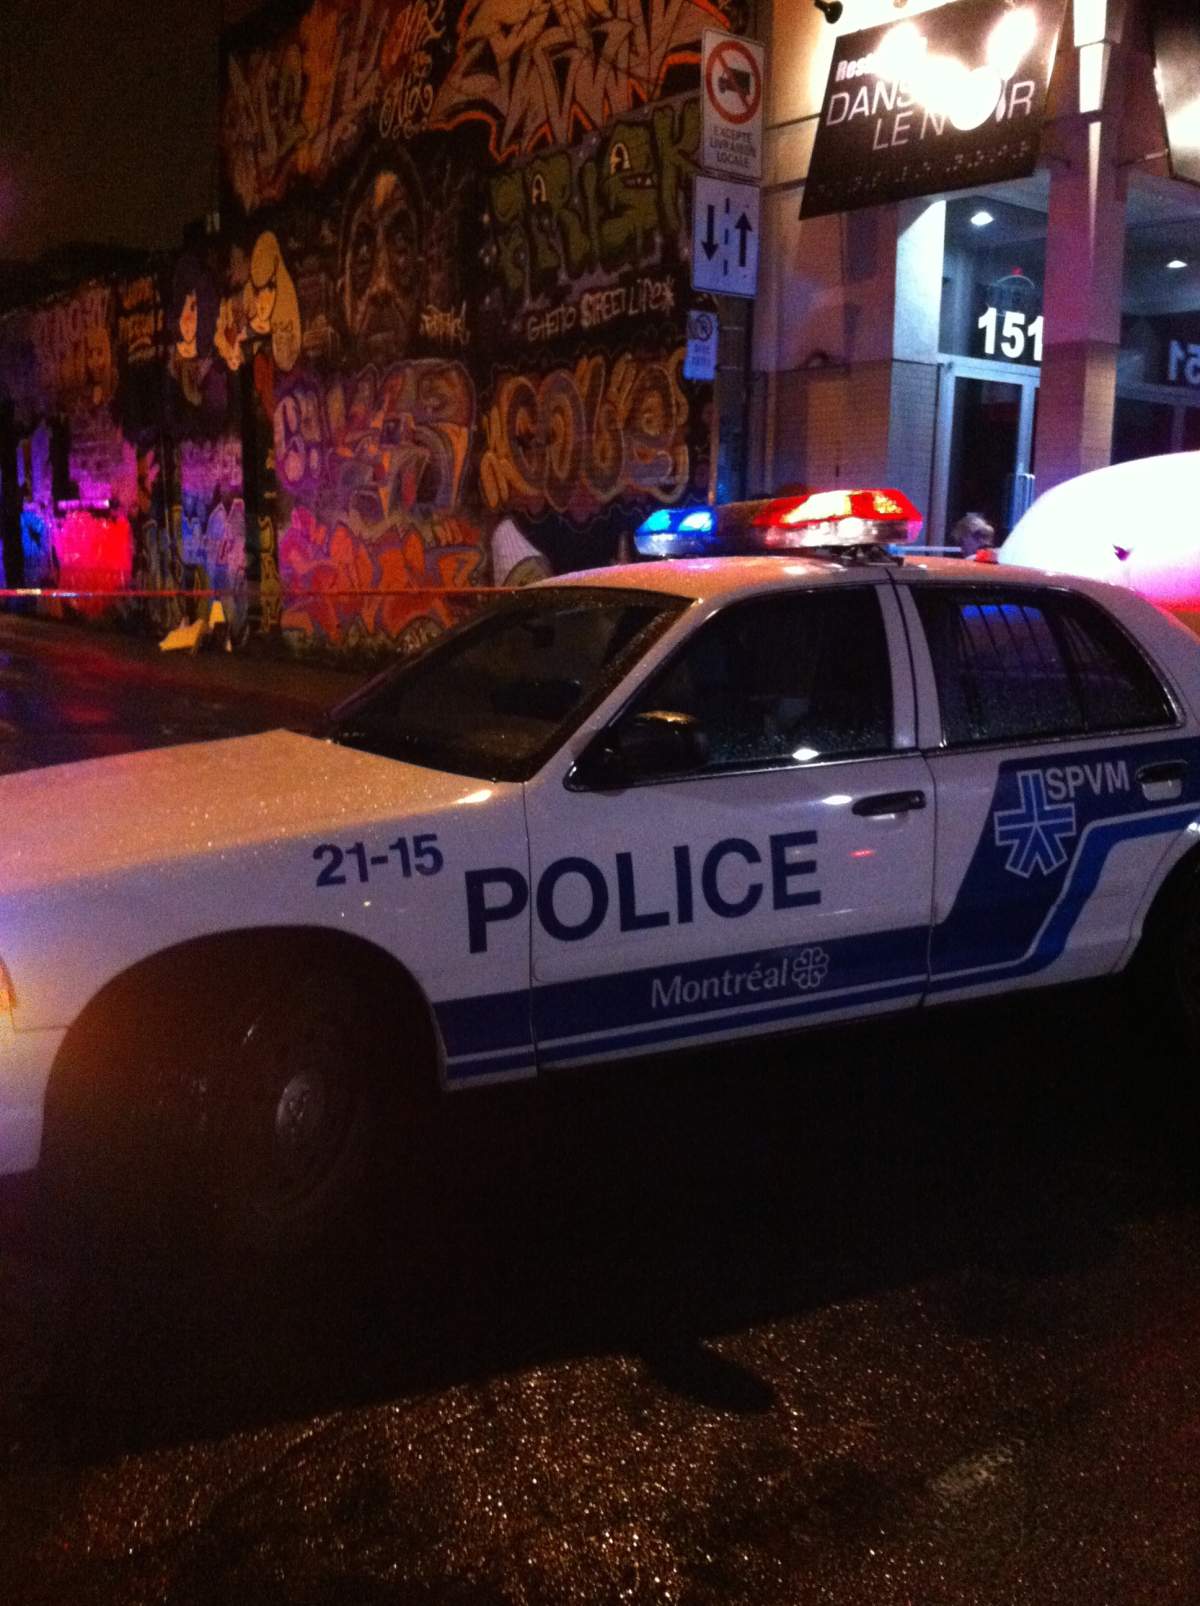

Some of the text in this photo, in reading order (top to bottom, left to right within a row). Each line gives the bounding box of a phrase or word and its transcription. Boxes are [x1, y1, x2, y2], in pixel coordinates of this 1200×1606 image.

[872, 110, 914, 151] LE
[978, 306, 1044, 362] 151
[1045, 760, 1131, 800] SPVM
[312, 834, 444, 887] 21-15
[464, 830, 822, 954] POLICE
[651, 968, 790, 1009] Montréal
